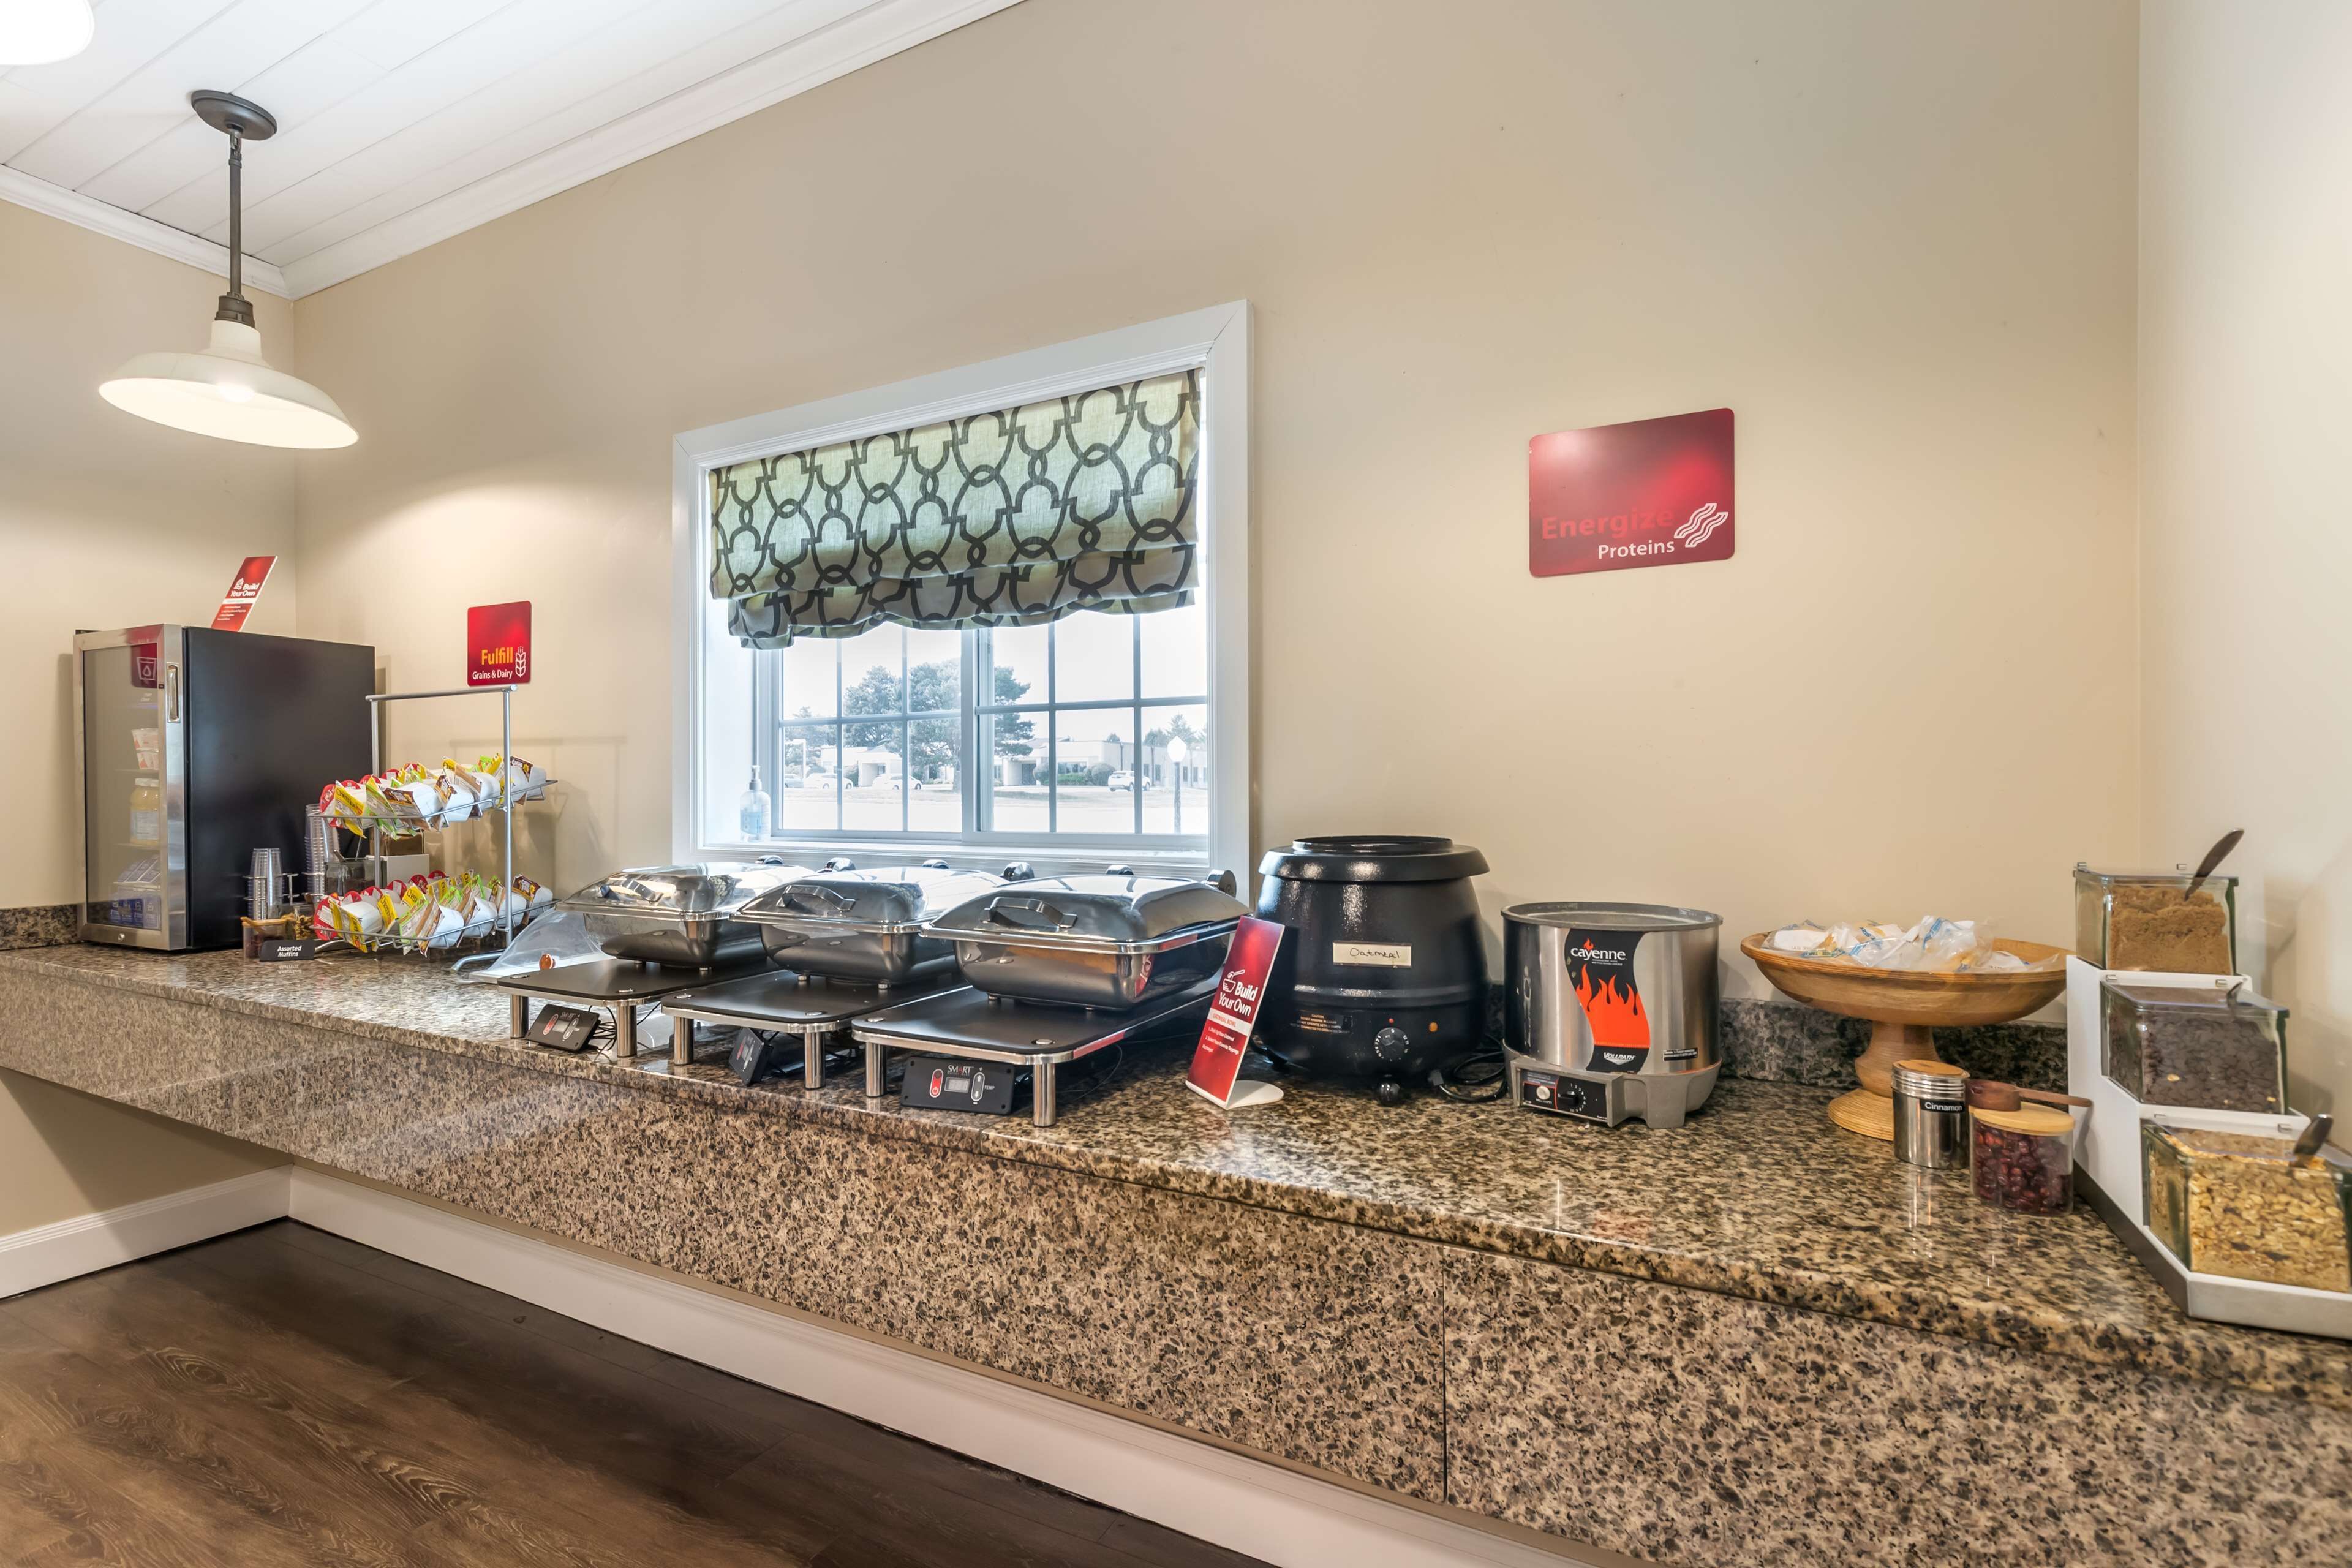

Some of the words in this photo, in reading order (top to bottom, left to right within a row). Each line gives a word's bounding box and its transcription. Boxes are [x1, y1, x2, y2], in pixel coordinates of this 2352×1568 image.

[1542, 507, 1675, 540] Energize
[1598, 540, 1675, 559] Proteins
[481, 646, 513, 665] Fulfill
[472, 671, 491, 680] Grains
[491, 669, 496, 679] &
[497, 669, 513, 680] Dairy
[1349, 947, 1400, 959] Oatmeal
[1570, 948, 1626, 961] cayenne
[1235, 981, 1259, 1002] Build
[1218, 992, 1235, 1009] Your
[1233, 998, 1252, 1017] Own
[1924, 1102, 1962, 1111] Cinnamon
